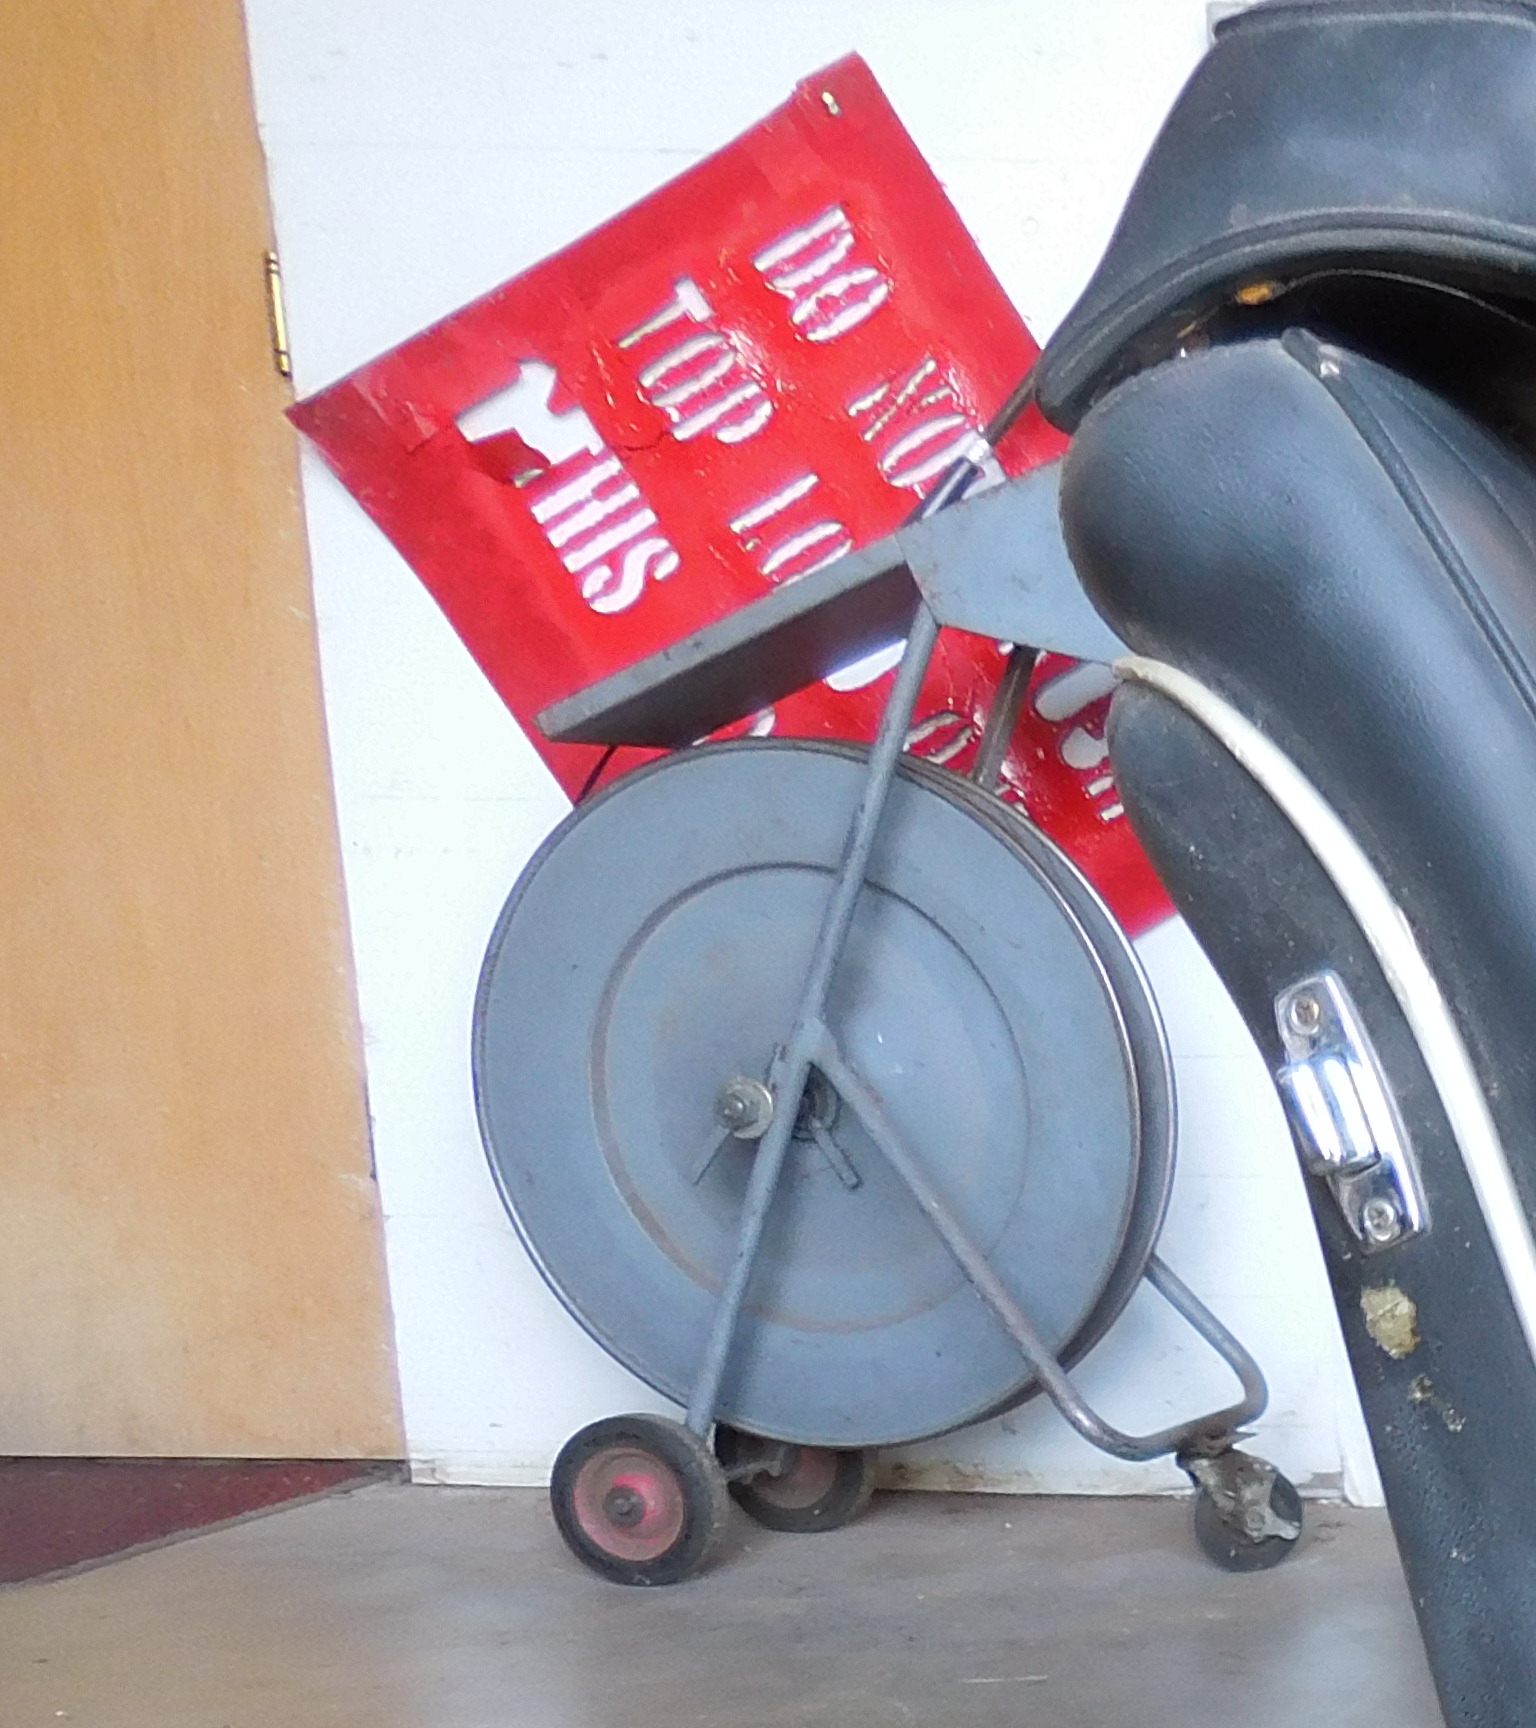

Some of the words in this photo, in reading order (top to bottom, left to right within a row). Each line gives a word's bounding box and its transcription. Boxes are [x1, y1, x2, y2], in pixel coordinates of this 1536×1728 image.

[753, 204, 891, 343] DO
[617, 275, 776, 445] TOP
[458, 361, 682, 615] THIS
